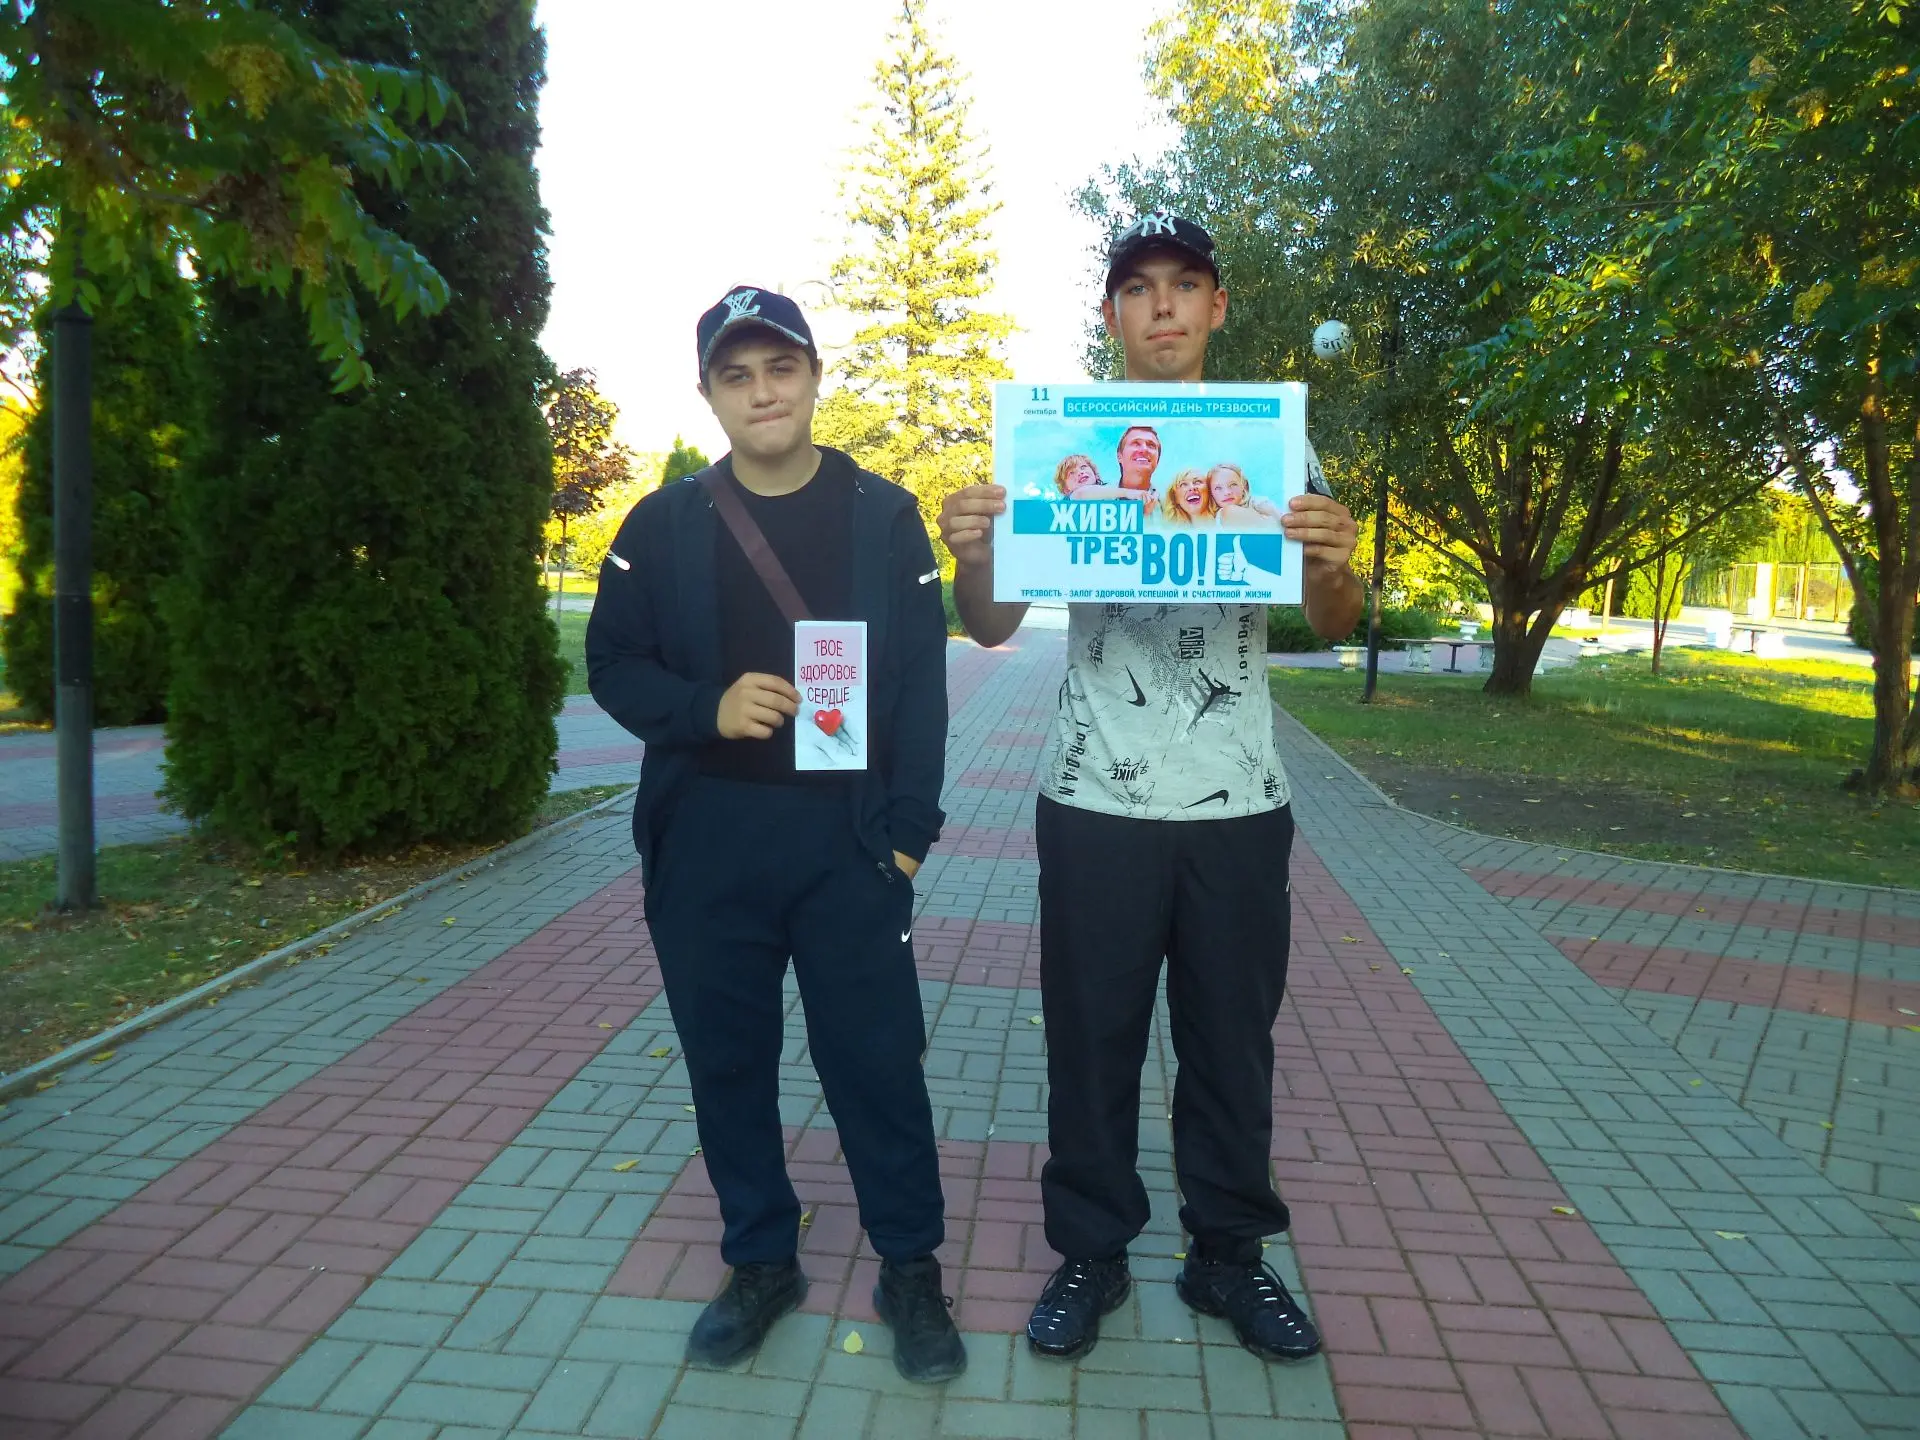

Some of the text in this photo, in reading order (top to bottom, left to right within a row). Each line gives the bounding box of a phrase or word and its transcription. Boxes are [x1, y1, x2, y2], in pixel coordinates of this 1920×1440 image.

[1031, 387, 1050, 401] 11
[1067, 400, 1271, 414] ВСЕРОССИЙСКИЙ ДЕНЬ ТРЕЗВОСТИ
[1049, 503, 1138, 533] ЖИВИ
[1021, 589, 1063, 597] ТРЕЗВОСТЬ
[1070, 590, 1093, 598] ЗАЛОГ
[1138, 589, 1179, 598] УСПЕШНОЙ
[1182, 590, 1188, 598] И
[1192, 589, 1241, 598] СЧАСТЛИВОЙ
[1245, 590, 1272, 598] ЖИЗНИ
[814, 639, 843, 657] ТВОЕ
[1179, 626, 1205, 659] AIR
[800, 664, 857, 683] ЗДОРОВОЕ
[807, 686, 850, 709] СЕРДЦЕ
